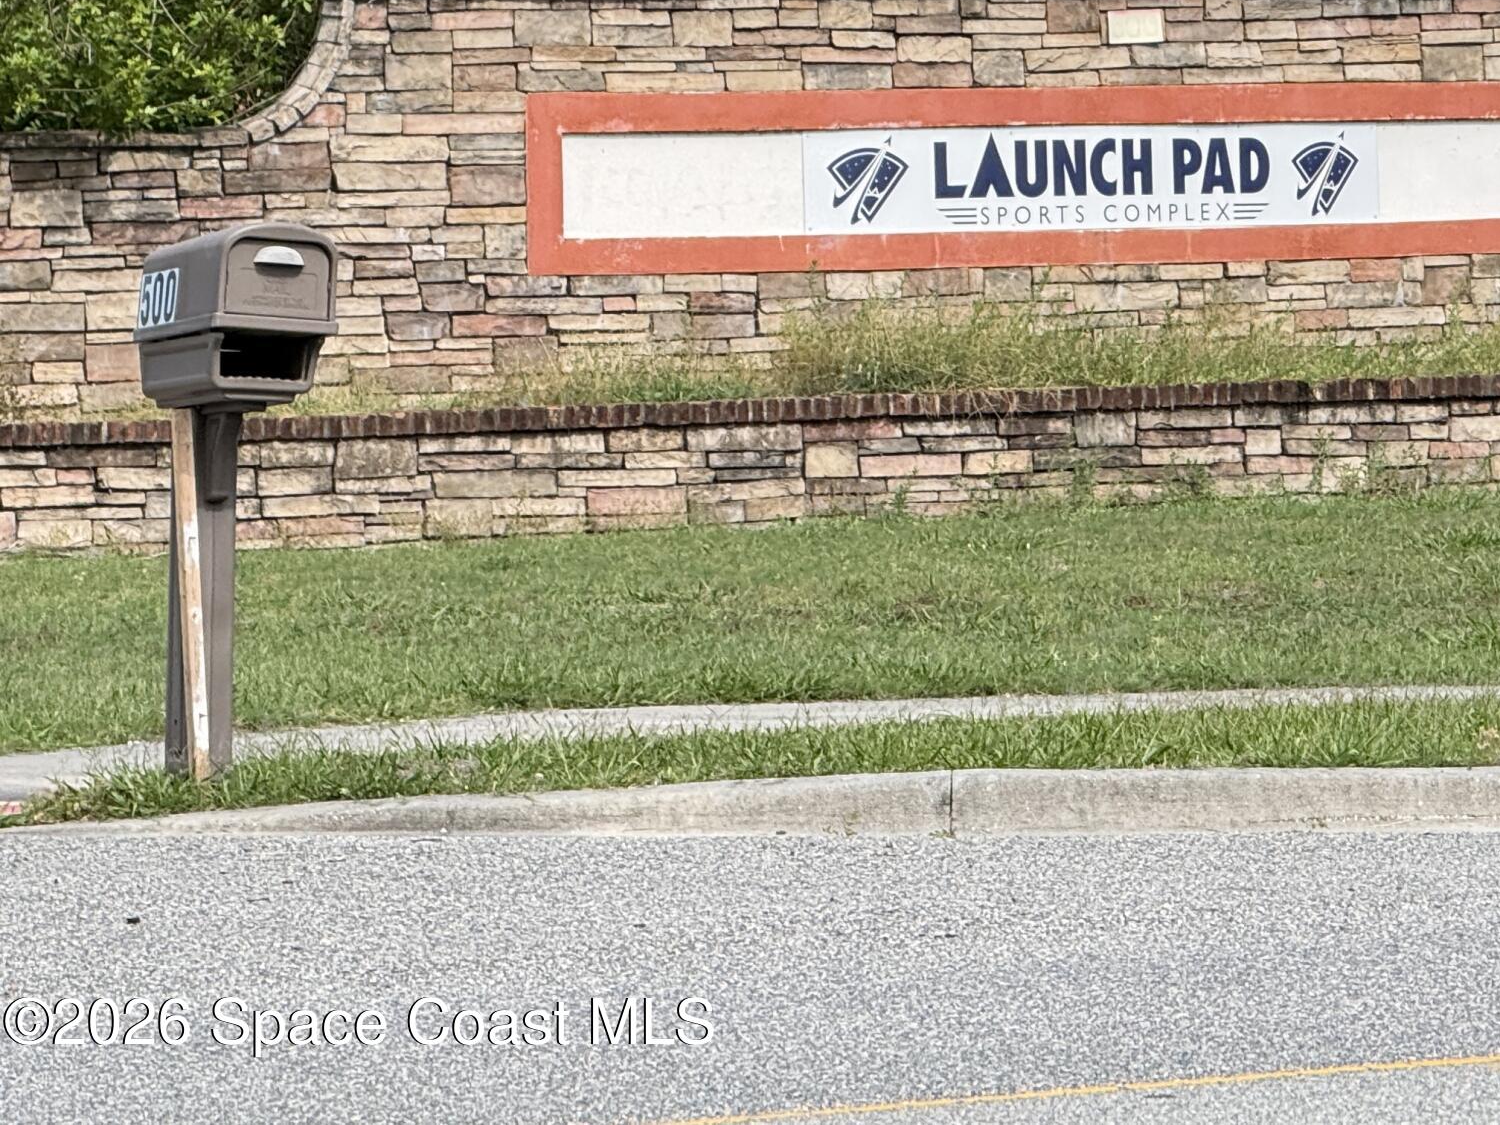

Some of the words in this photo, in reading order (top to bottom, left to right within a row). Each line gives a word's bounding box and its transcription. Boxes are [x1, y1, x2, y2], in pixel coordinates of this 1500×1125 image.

[934, 133, 1153, 199] LAUNCH
[1172, 137, 1270, 195] PAD
[980, 204, 1086, 225] SPORTS
[1103, 203, 1232, 222] COMPLEX
[140, 270, 177, 326] 500
